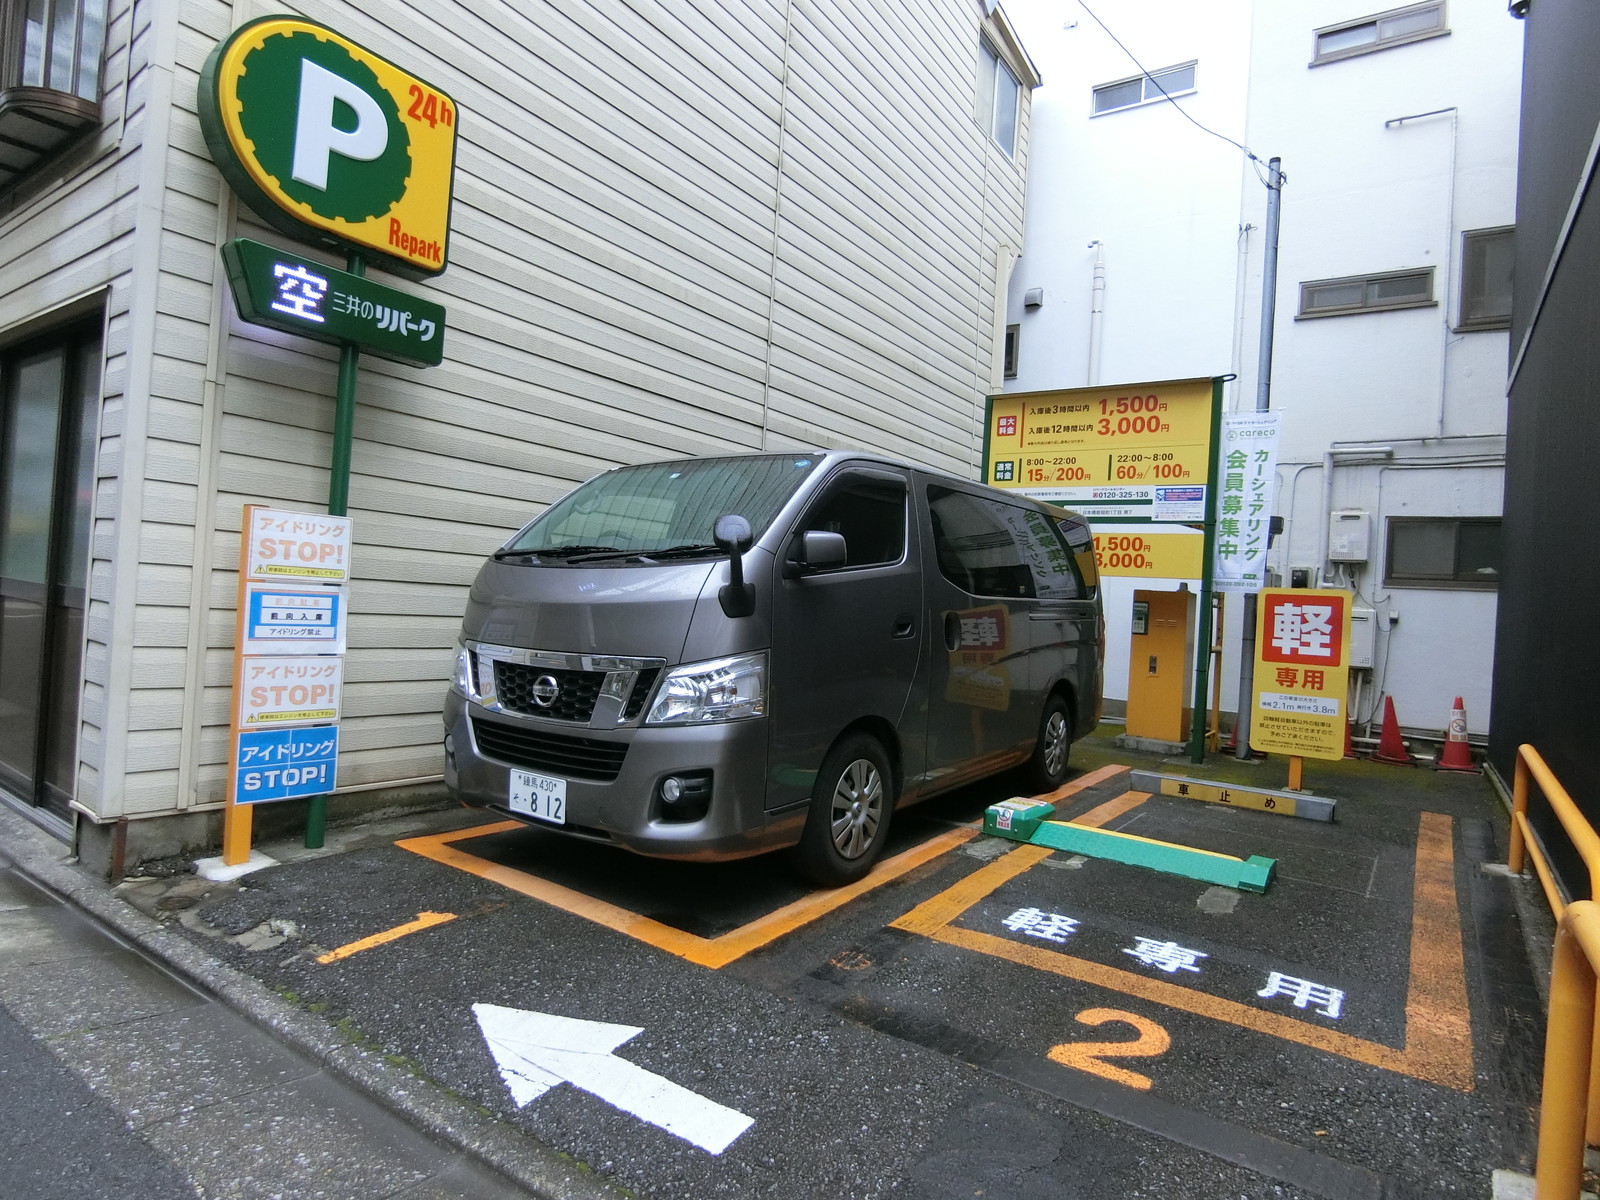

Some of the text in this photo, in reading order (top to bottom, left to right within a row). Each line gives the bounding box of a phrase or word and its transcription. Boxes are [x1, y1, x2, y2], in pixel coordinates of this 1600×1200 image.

[407, 85, 452, 129] 24h
[292, 56, 388, 192] P
[389, 217, 442, 264] Repark
[271, 262, 328, 322] 空
[1239, 428, 1275, 437] careco
[1218, 449, 1248, 560] 会員募集中
[1243, 449, 1269, 561] カーシェアリング
[260, 517, 346, 538] アイドリング
[258, 538, 343, 564] STOP!
[269, 628, 322, 636] アイドリング禁止
[1271, 602, 1332, 657] 軽
[251, 664, 337, 679] アイドリング
[1275, 667, 1324, 690] 専用
[249, 684, 335, 708] STOP!
[534, 686, 558, 696] NISSAN
[242, 739, 335, 762] アイドリング
[244, 764, 327, 790] STOP!
[523, 775, 554, 792] 練馬 430
[1178, 783, 1276, 809] 車止め
[1046, 1007, 1172, 1091] 2
